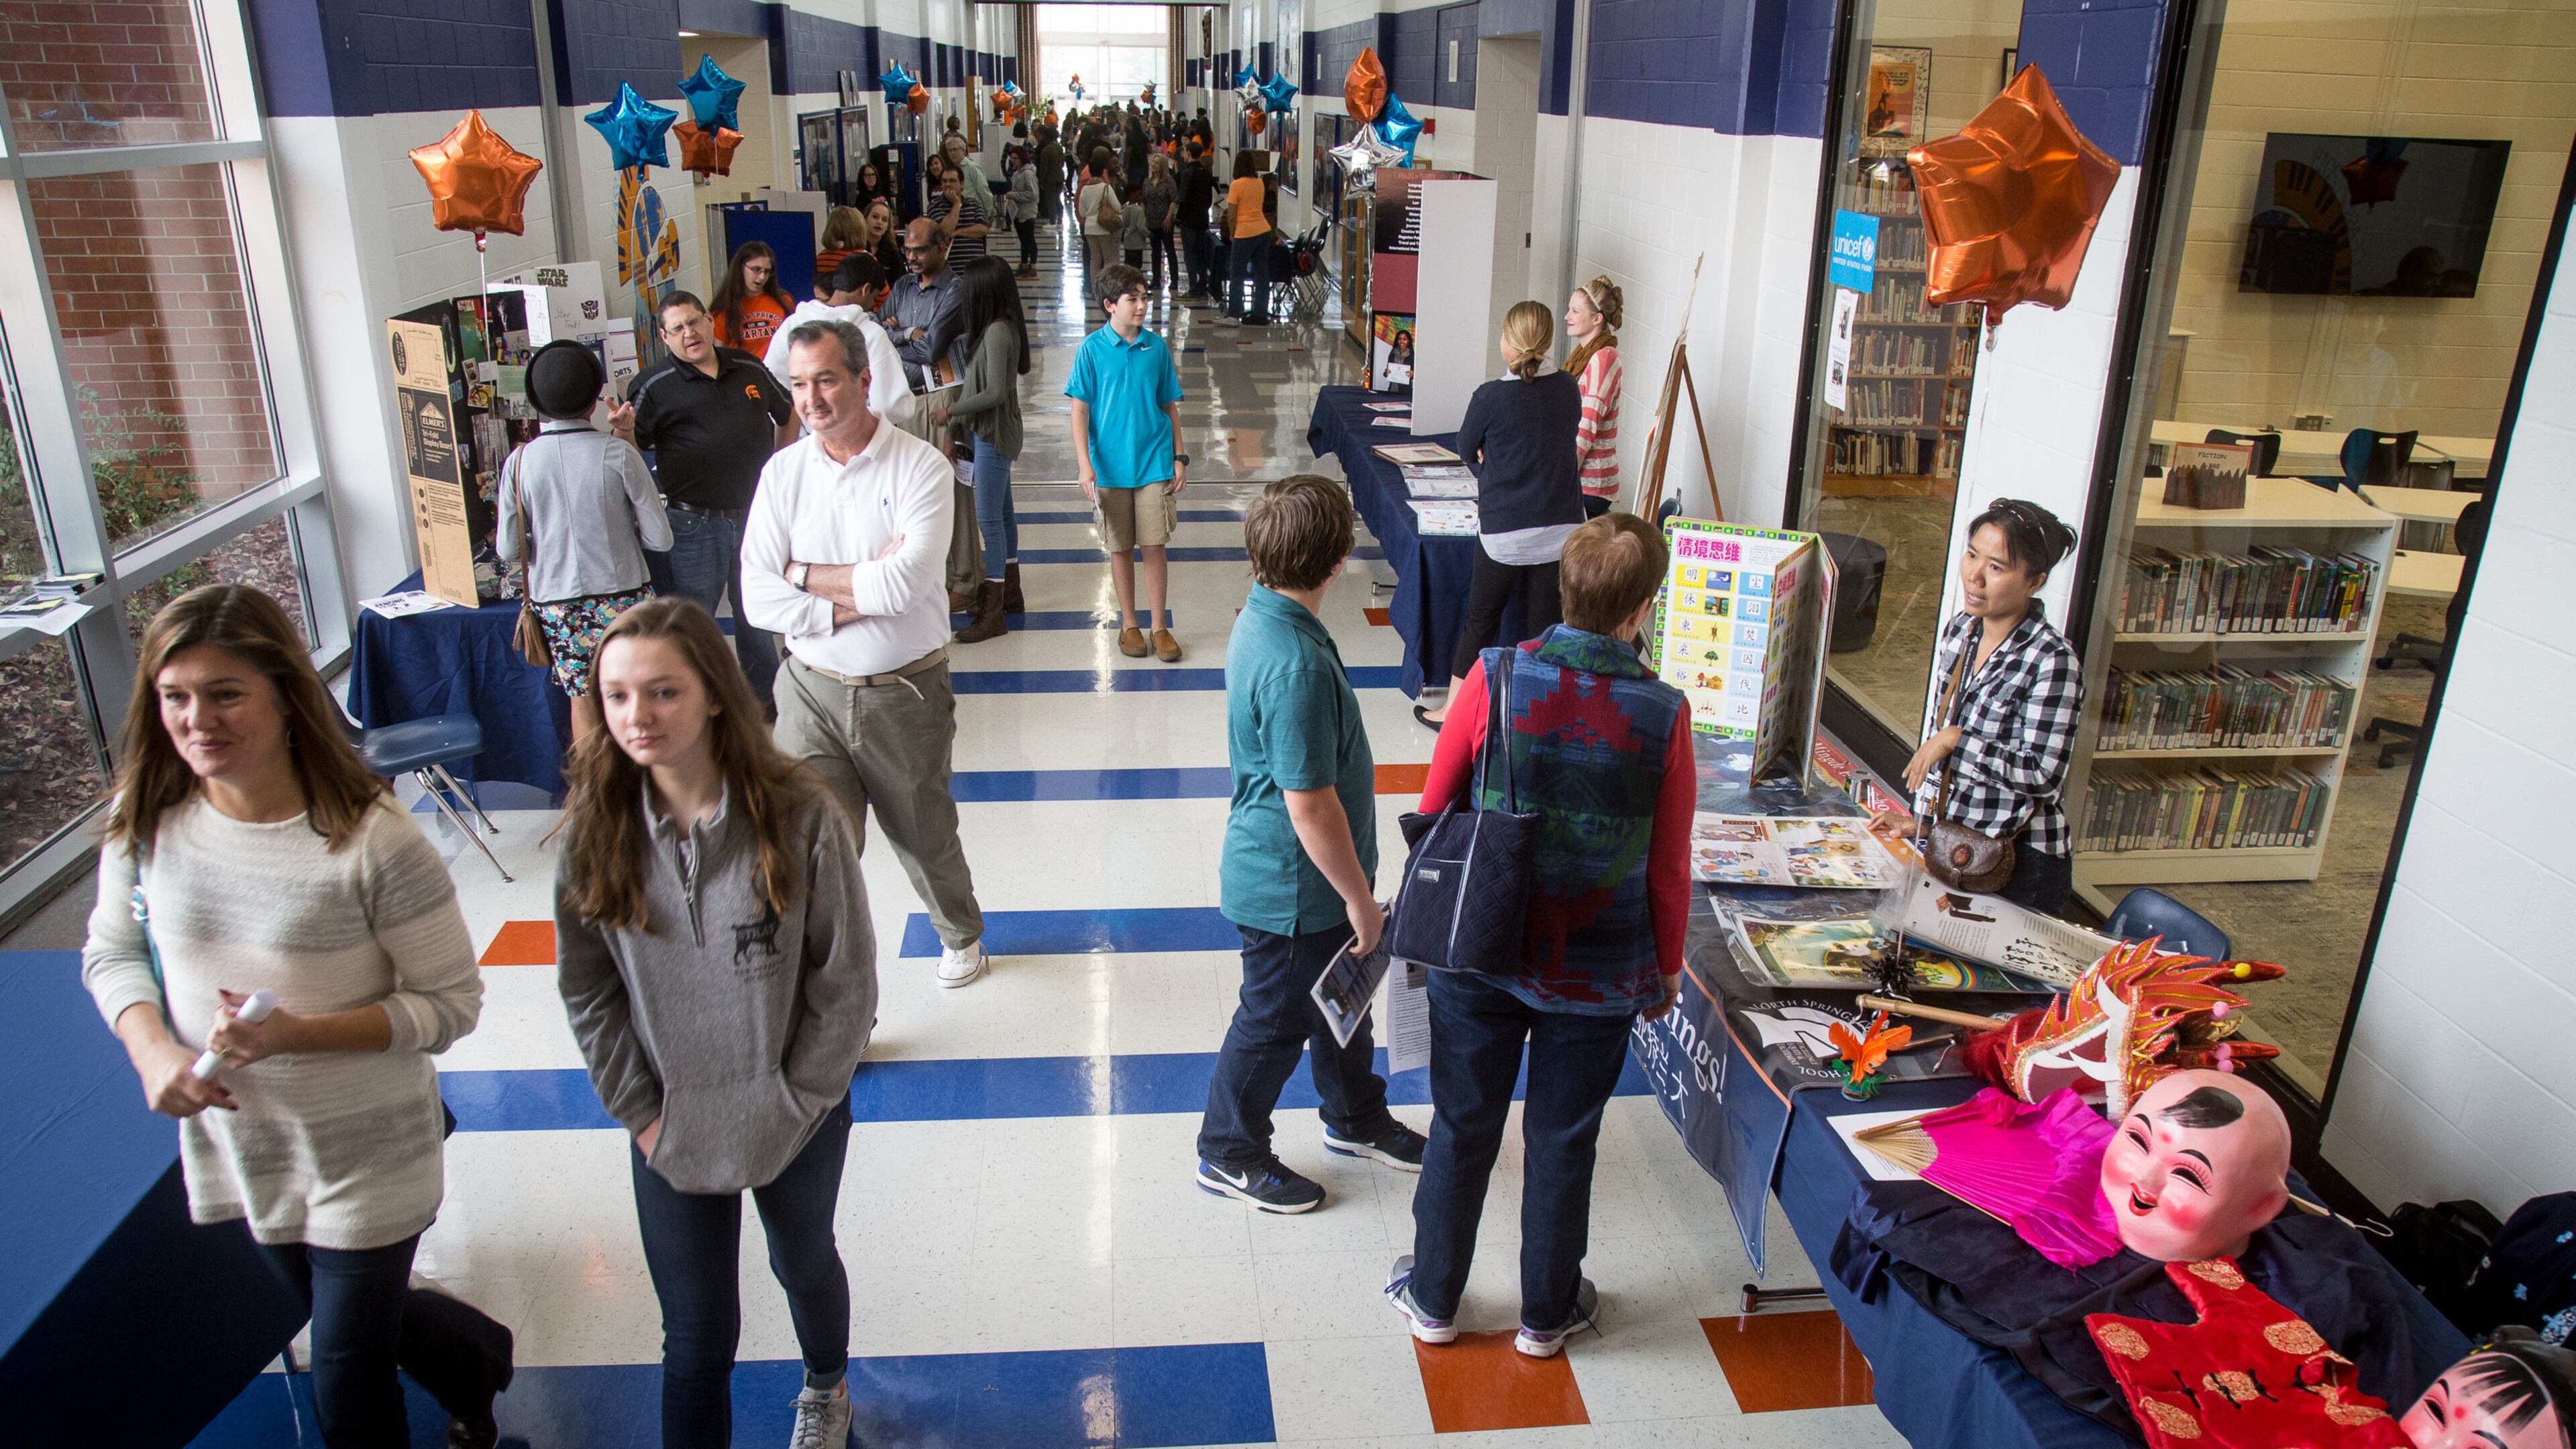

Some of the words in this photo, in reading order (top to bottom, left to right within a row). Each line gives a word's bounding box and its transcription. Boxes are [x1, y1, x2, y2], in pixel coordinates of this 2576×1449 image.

[1834, 231, 1864, 258] unicef
[537, 268, 568, 278] STAR
[537, 277, 568, 287] WARS
[751, 311, 783, 323] SPRINGS
[740, 326, 779, 340] PARTAN
[422, 417, 445, 429] ELMER'S
[2198, 451, 2228, 460] FICTION
[1677, 536, 1742, 563] 情境思维
[1686, 568, 1699, 581] 明
[1750, 576, 1762, 588] 尘
[1684, 593, 1696, 606] 休
[1748, 602, 1760, 614] 泪
[1743, 654, 1754, 665] 囚
[1737, 704, 1749, 715] 比
[1748, 999, 1797, 1012] NORTH
